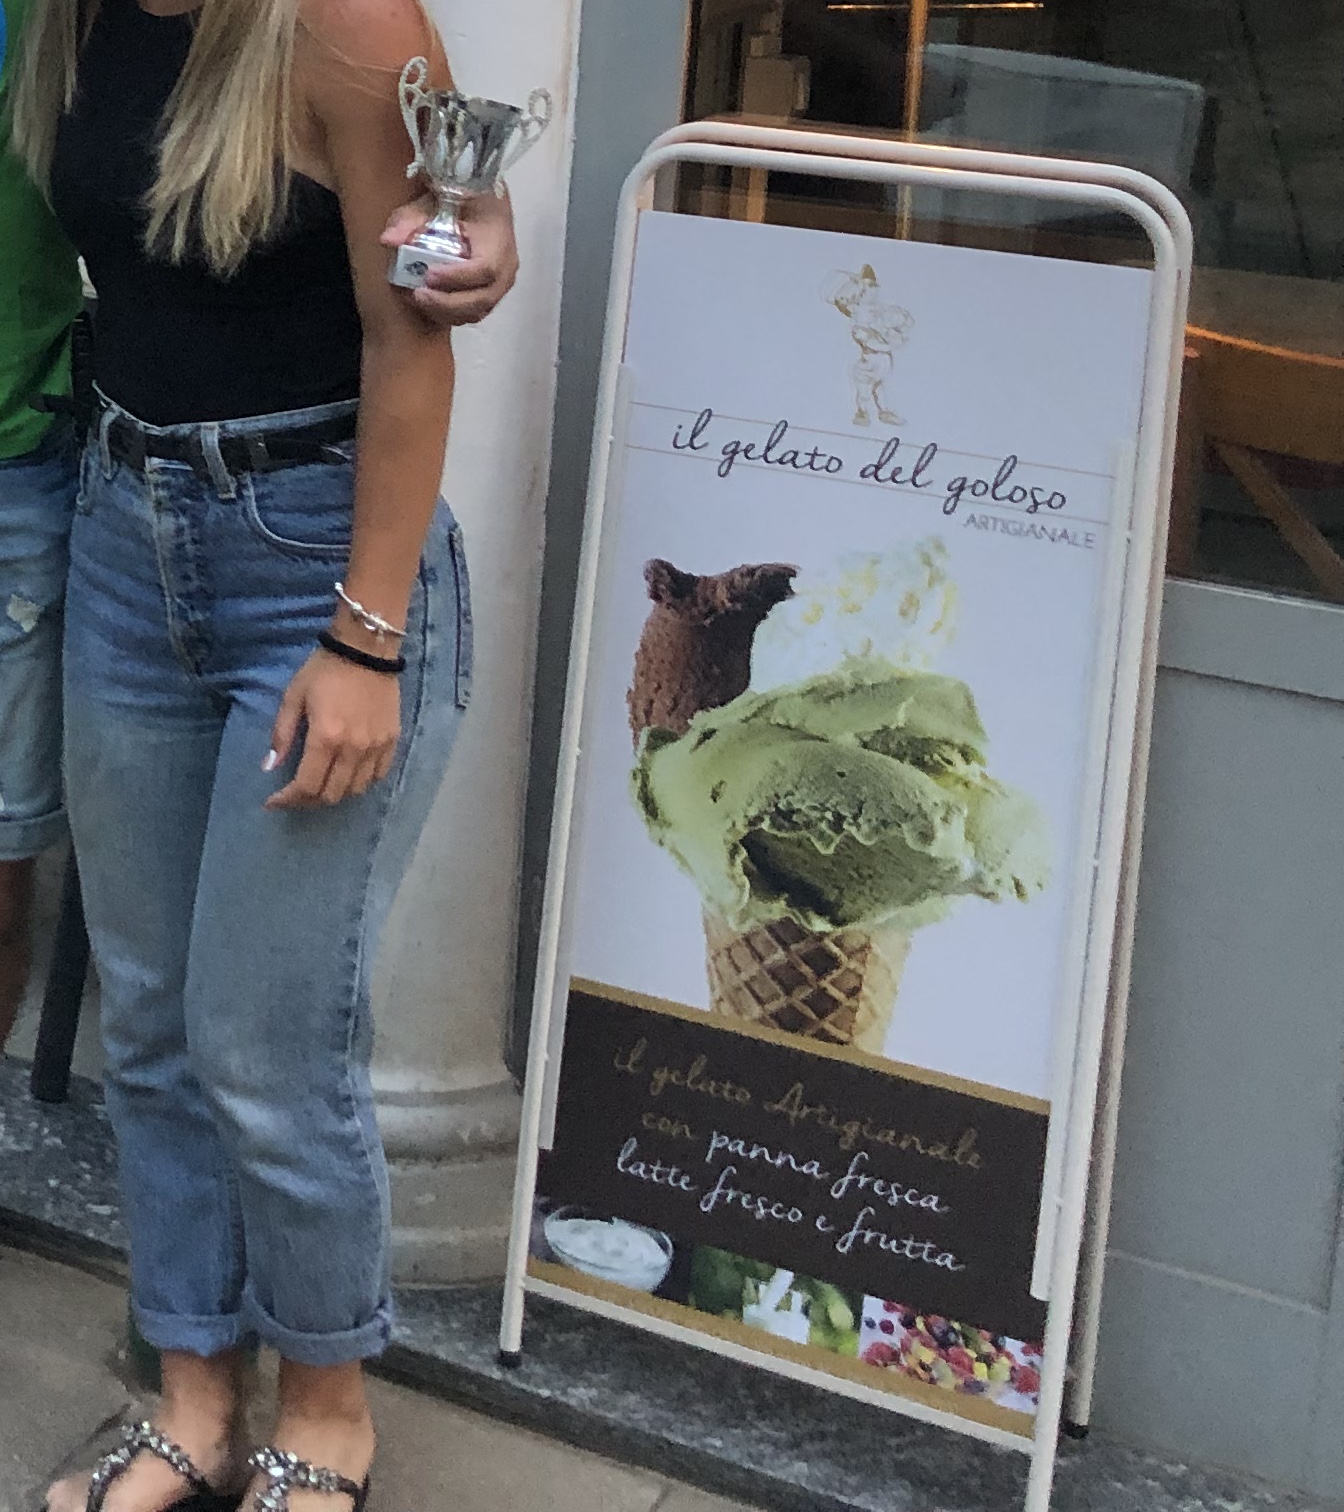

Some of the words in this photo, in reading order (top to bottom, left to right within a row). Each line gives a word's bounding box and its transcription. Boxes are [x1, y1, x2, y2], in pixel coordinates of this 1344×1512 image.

[671, 408, 712, 451] il
[718, 420, 843, 477] gelato
[859, 437, 937, 488] del
[942, 455, 1067, 515] goloso
[963, 513, 1096, 550] ARTIGIANALE
[641, 1111, 696, 1141] con
[705, 1130, 829, 1180] panna
[830, 1151, 951, 1214] fresca
[649, 1054, 751, 1104] gelato
[763, 1082, 983, 1169] Artigianale
[616, 1137, 699, 1191] latte
[699, 1165, 803, 1222] fresco
[816, 1215, 835, 1233] e
[835, 1206, 966, 1273] frutta
